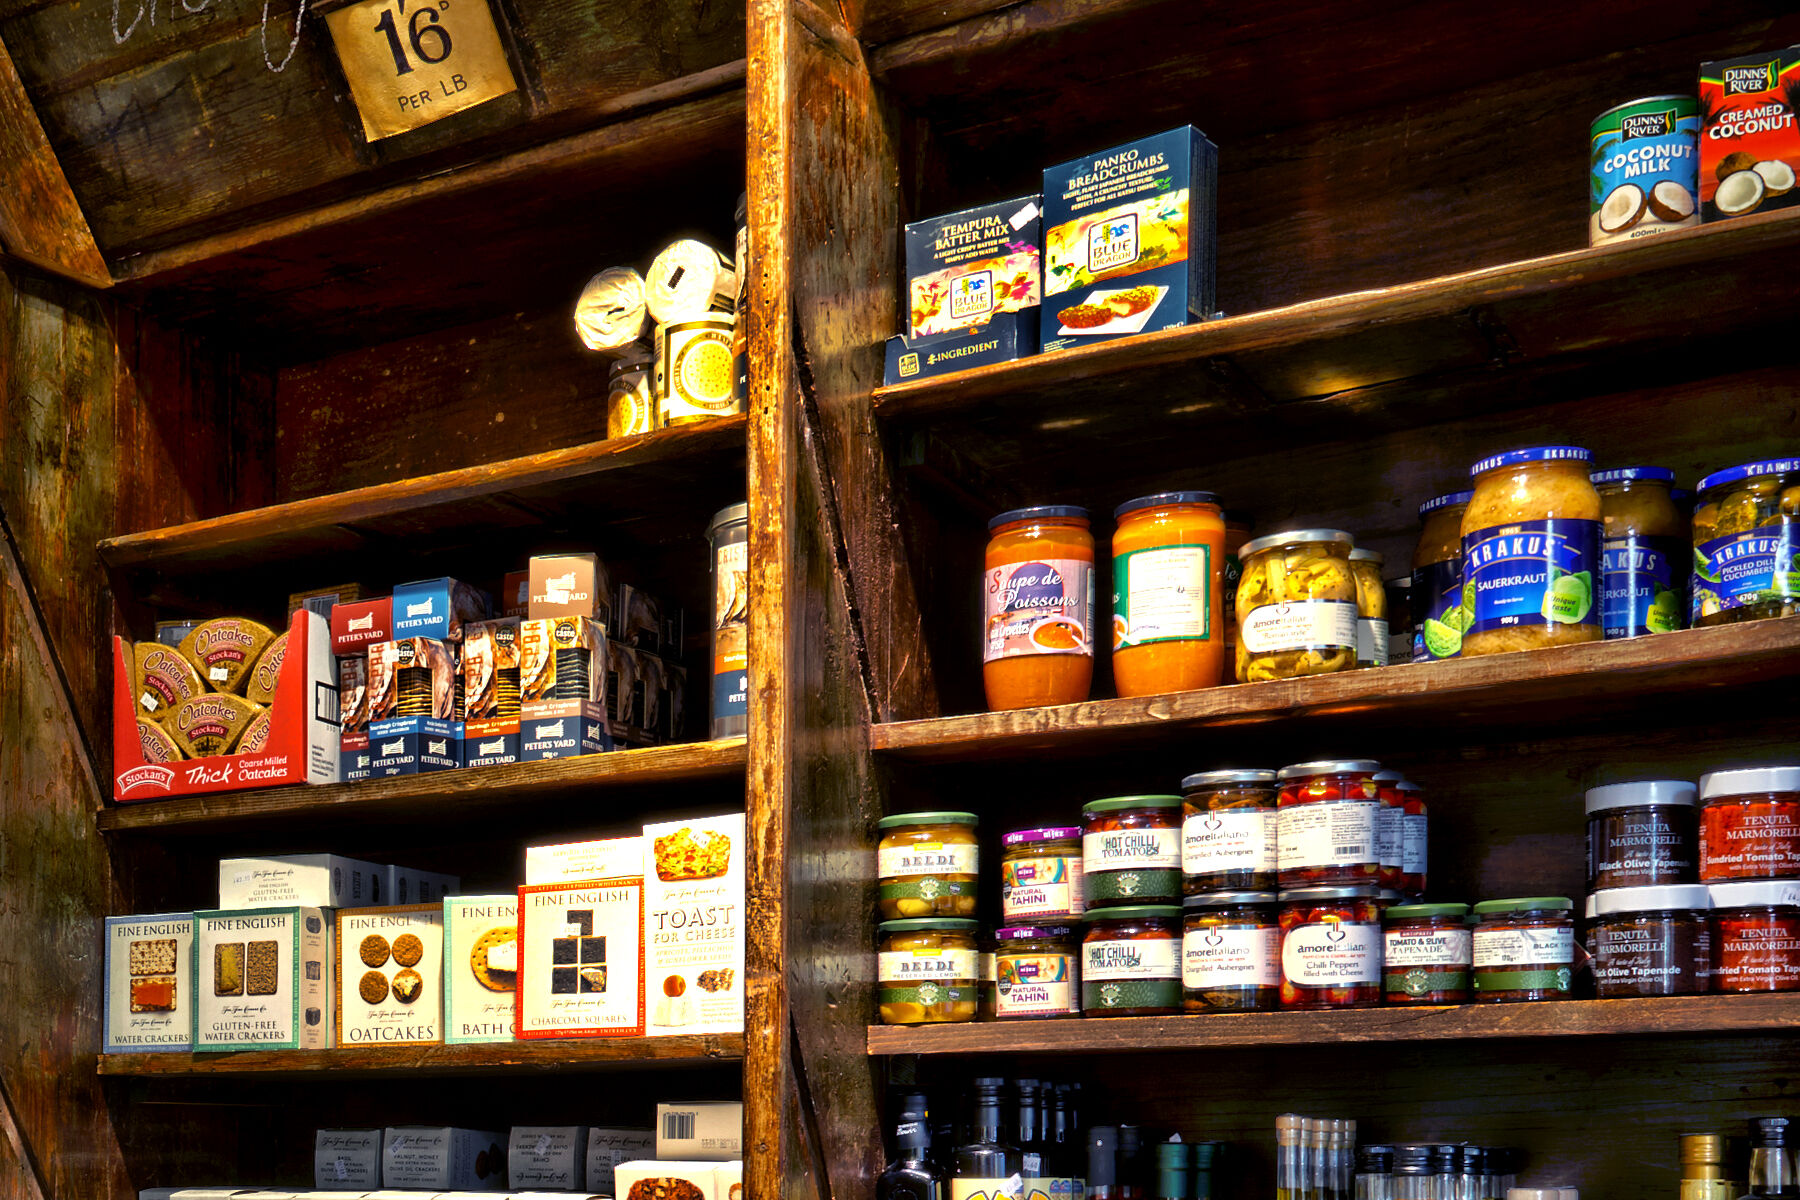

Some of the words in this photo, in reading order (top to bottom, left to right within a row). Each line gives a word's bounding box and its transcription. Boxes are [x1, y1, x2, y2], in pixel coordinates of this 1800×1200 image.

[1725, 67, 1767, 83] DUNN'S
[398, 90, 432, 112] PER
[440, 74, 467, 96] LB
[1730, 80, 1763, 93] RIVER
[1720, 104, 1784, 124] CREAMED
[1624, 115, 1664, 131] DUNN'S
[1710, 114, 1795, 140] COCONUT
[1628, 125, 1660, 138] RIVER
[1094, 149, 1138, 172] PANKO
[1604, 145, 1692, 174] COCONUT
[1068, 153, 1164, 190] BREADCRUMBS
[1624, 159, 1670, 179] MILK
[941, 215, 1002, 237] TEMPURA
[1631, 227, 1657, 239] 400ml
[935, 230, 981, 251] BATTER
[983, 224, 1009, 239] MIX
[1093, 239, 1131, 259] BLUE
[1093, 251, 1131, 267] DRAGON
[955, 292, 987, 307] BLUE
[1471, 538, 1554, 568] KRAKUS
[1714, 540, 1780, 564] KRAKUS
[1722, 563, 1751, 575] PICKLED
[1753, 558, 1774, 568] DILL
[1723, 565, 1774, 581] CUCUMBERS
[989, 569, 1039, 594] Soupe
[1040, 569, 1064, 585] de
[1477, 573, 1547, 591] SAUERKRAUT
[997, 589, 1078, 613] Poissons
[1550, 596, 1577, 606] Unique
[1739, 592, 1758, 602] 670g
[1552, 604, 1572, 612] taste
[396, 618, 421, 629] PETER'S
[423, 615, 444, 625] YARD
[195, 628, 254, 657] Oatcakes
[338, 632, 362, 643] PETER'S
[364, 630, 383, 640] YARD
[208, 651, 242, 662] Stockan's
[143, 651, 191, 700] Oatcakes
[147, 675, 174, 703] Stockan's
[178, 704, 237, 731] Oatcakes
[191, 725, 224, 737] Stockan's
[524, 740, 552, 751] PETER'S
[553, 738, 576, 749] YARD
[239, 759, 263, 768] Coarse
[264, 756, 287, 765] Milled
[126, 771, 167, 784] Stockan's
[186, 764, 233, 784] Thick
[239, 766, 287, 781] Oatcakes
[1625, 823, 1670, 833] TENUTA
[1105, 836, 1123, 849] HOT
[1125, 834, 1155, 847] CHILLI
[1610, 835, 1683, 847] MARMORELLE
[1102, 846, 1160, 857] TOMATOES
[901, 855, 955, 867] BELDI
[1599, 862, 1621, 870] Black
[1623, 860, 1650, 868] Olive
[534, 895, 564, 907] FINE
[568, 890, 629, 904] ENGLISH
[1011, 894, 1046, 906] TAHINI
[207, 920, 231, 931] FINE
[233, 916, 286, 929] ENGLISH
[653, 904, 735, 930] TOAST
[118, 926, 141, 937] FINE
[143, 923, 190, 936] ENGLISH
[654, 932, 678, 944] FOR
[685, 927, 735, 942] CHEESE
[212, 1020, 278, 1030] GLUTEN-FREE
[531, 1016, 582, 1026] CHARCOAL
[204, 1031, 233, 1041] WATER
[235, 1030, 285, 1040] CRACKERS
[350, 1026, 433, 1041] OATCAKES
[462, 1023, 503, 1036] BATH
[115, 1035, 139, 1043] WATER
[140, 1034, 189, 1043] CRACKERS
